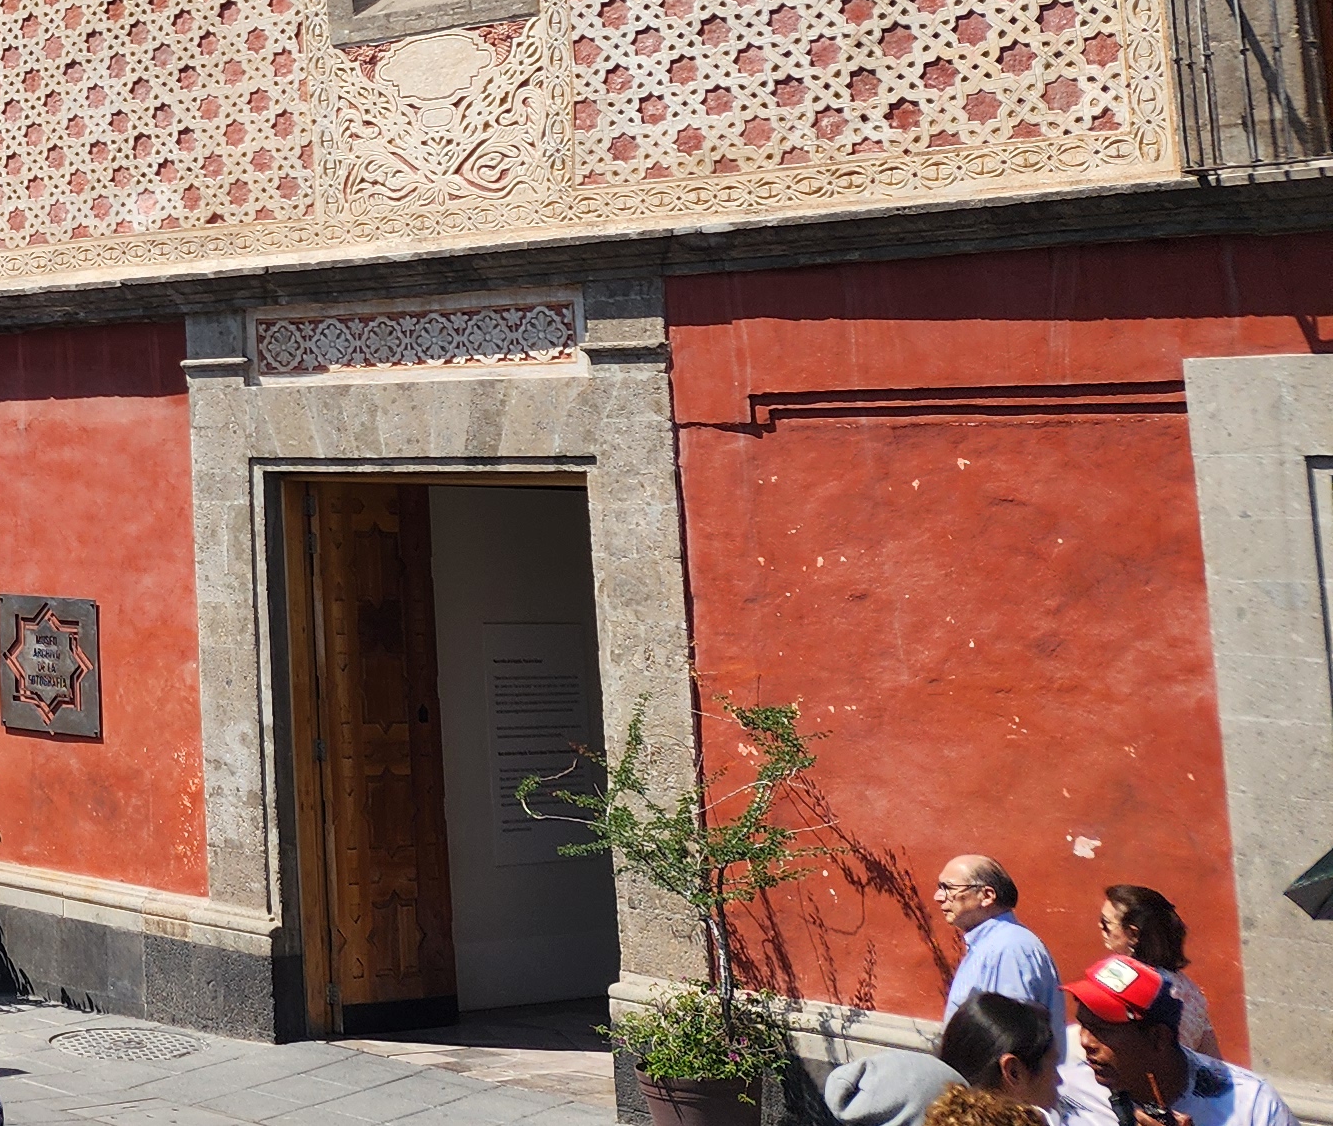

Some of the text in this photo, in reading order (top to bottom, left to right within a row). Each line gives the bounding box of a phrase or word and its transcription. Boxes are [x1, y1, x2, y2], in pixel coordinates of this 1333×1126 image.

[35, 634, 58, 647] MUSEO
[33, 648, 61, 660] ARCHIVO
[47, 662, 56, 674] LA
